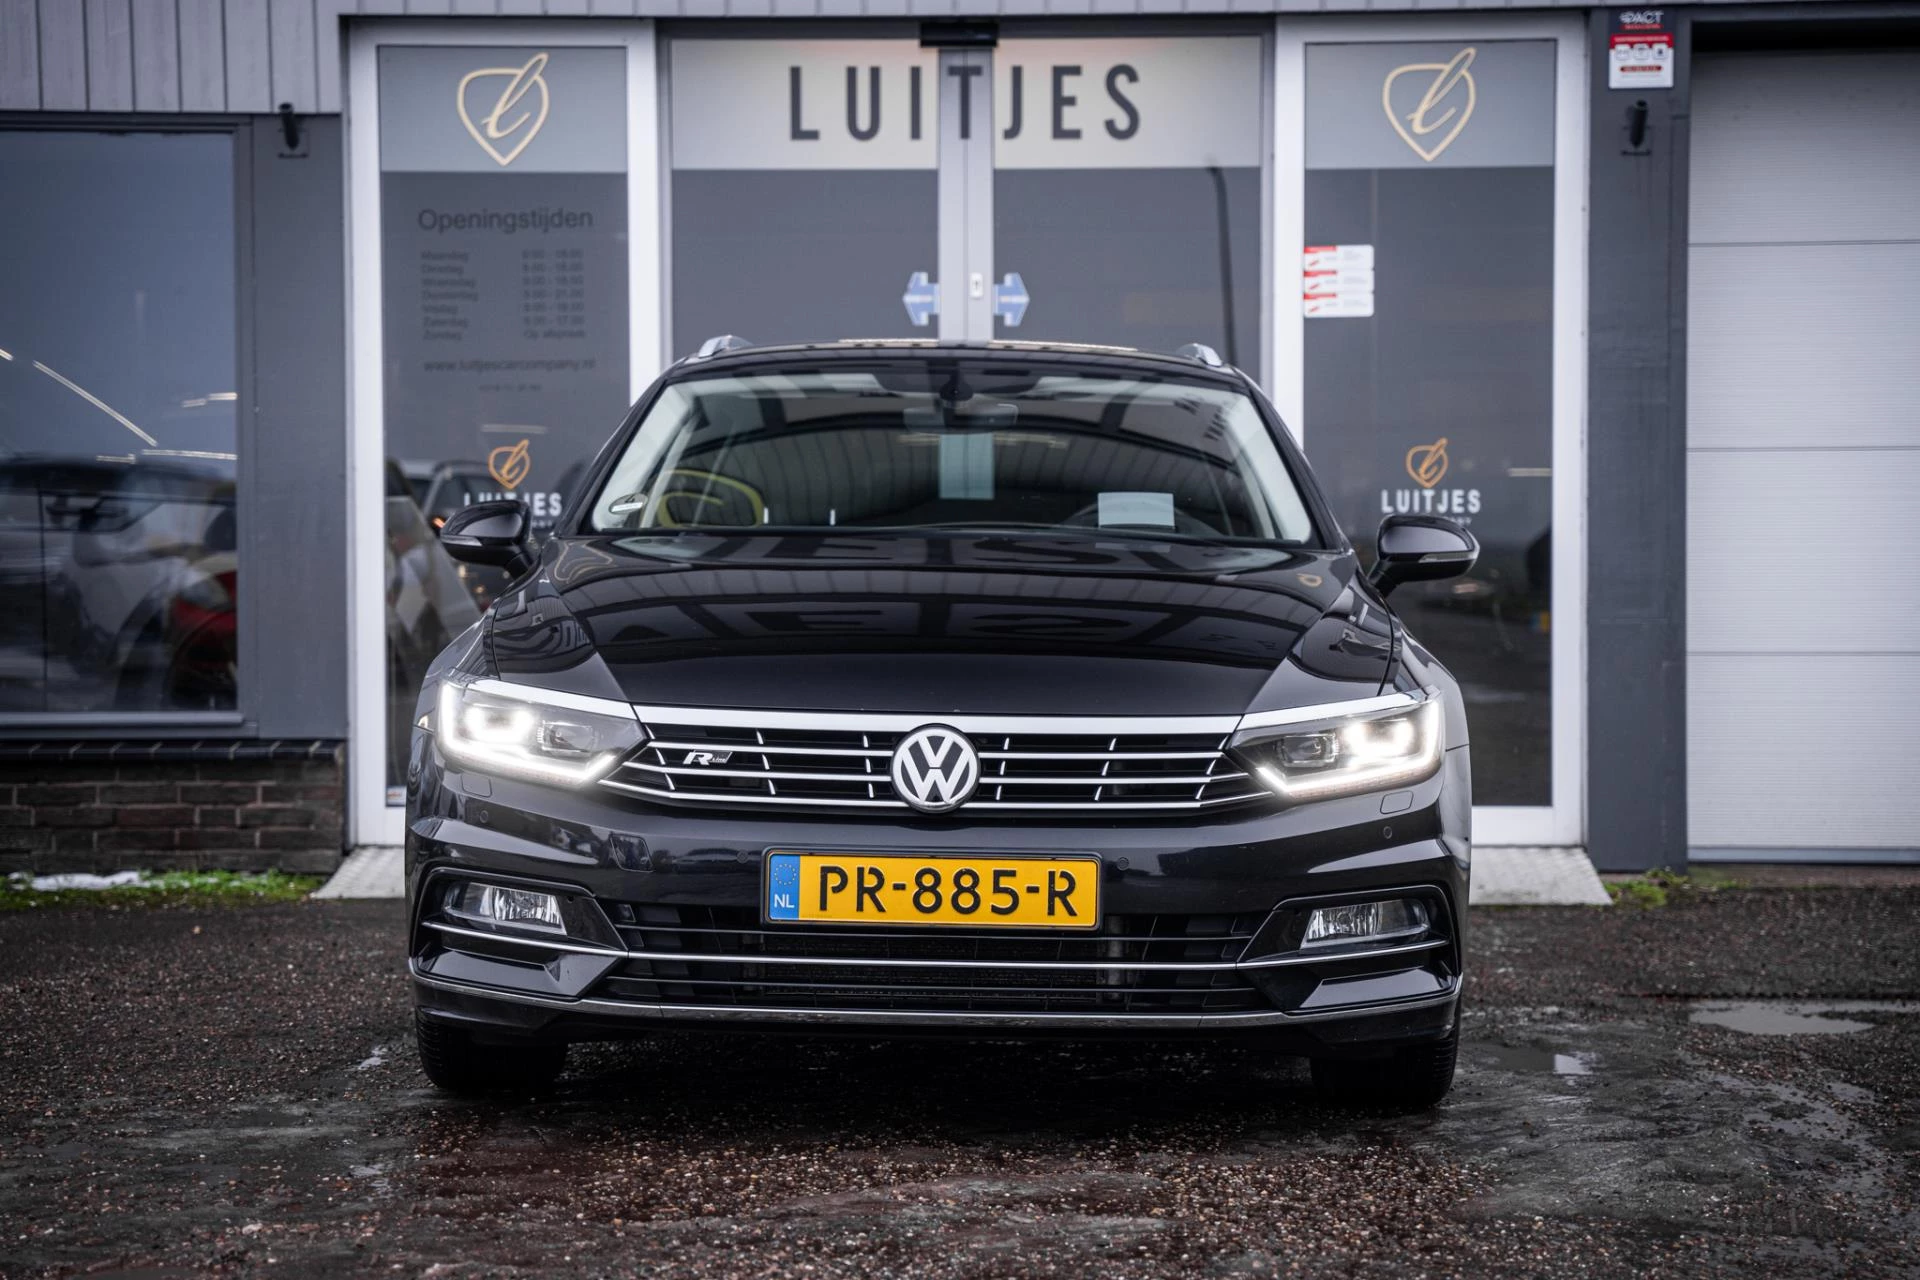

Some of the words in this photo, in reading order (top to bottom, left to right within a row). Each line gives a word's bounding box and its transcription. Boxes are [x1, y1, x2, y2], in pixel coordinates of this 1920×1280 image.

[790, 63, 1140, 141] LUITJES
[417, 208, 594, 234] Openingstijden
[1381, 489, 1481, 513] LUITJES
[774, 893, 795, 908] NL
[819, 865, 1078, 917] PR-885-R
